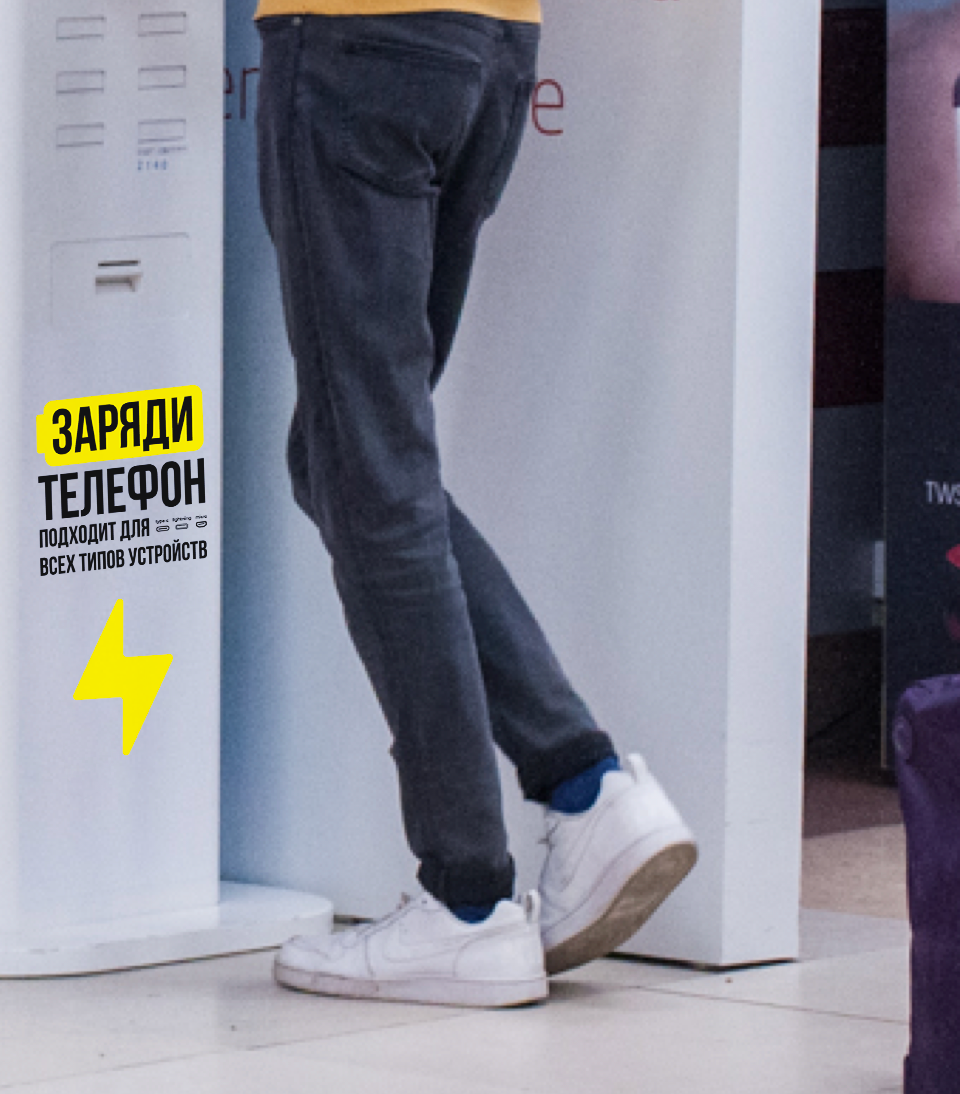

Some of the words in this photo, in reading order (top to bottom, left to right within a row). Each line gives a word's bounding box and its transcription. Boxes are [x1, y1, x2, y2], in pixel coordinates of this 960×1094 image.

[52, 395, 193, 455] ЗАРЯДИ
[38, 458, 206, 521] ТЕЛЕФОН
[39, 521, 116, 548] ПОДХОДИТ
[120, 518, 150, 541] ДЛЯ
[40, 555, 76, 577] ВСЕХ
[79, 549, 124, 572] ТИПОВ
[128, 538, 208, 566] УСТРОЙСТВ
